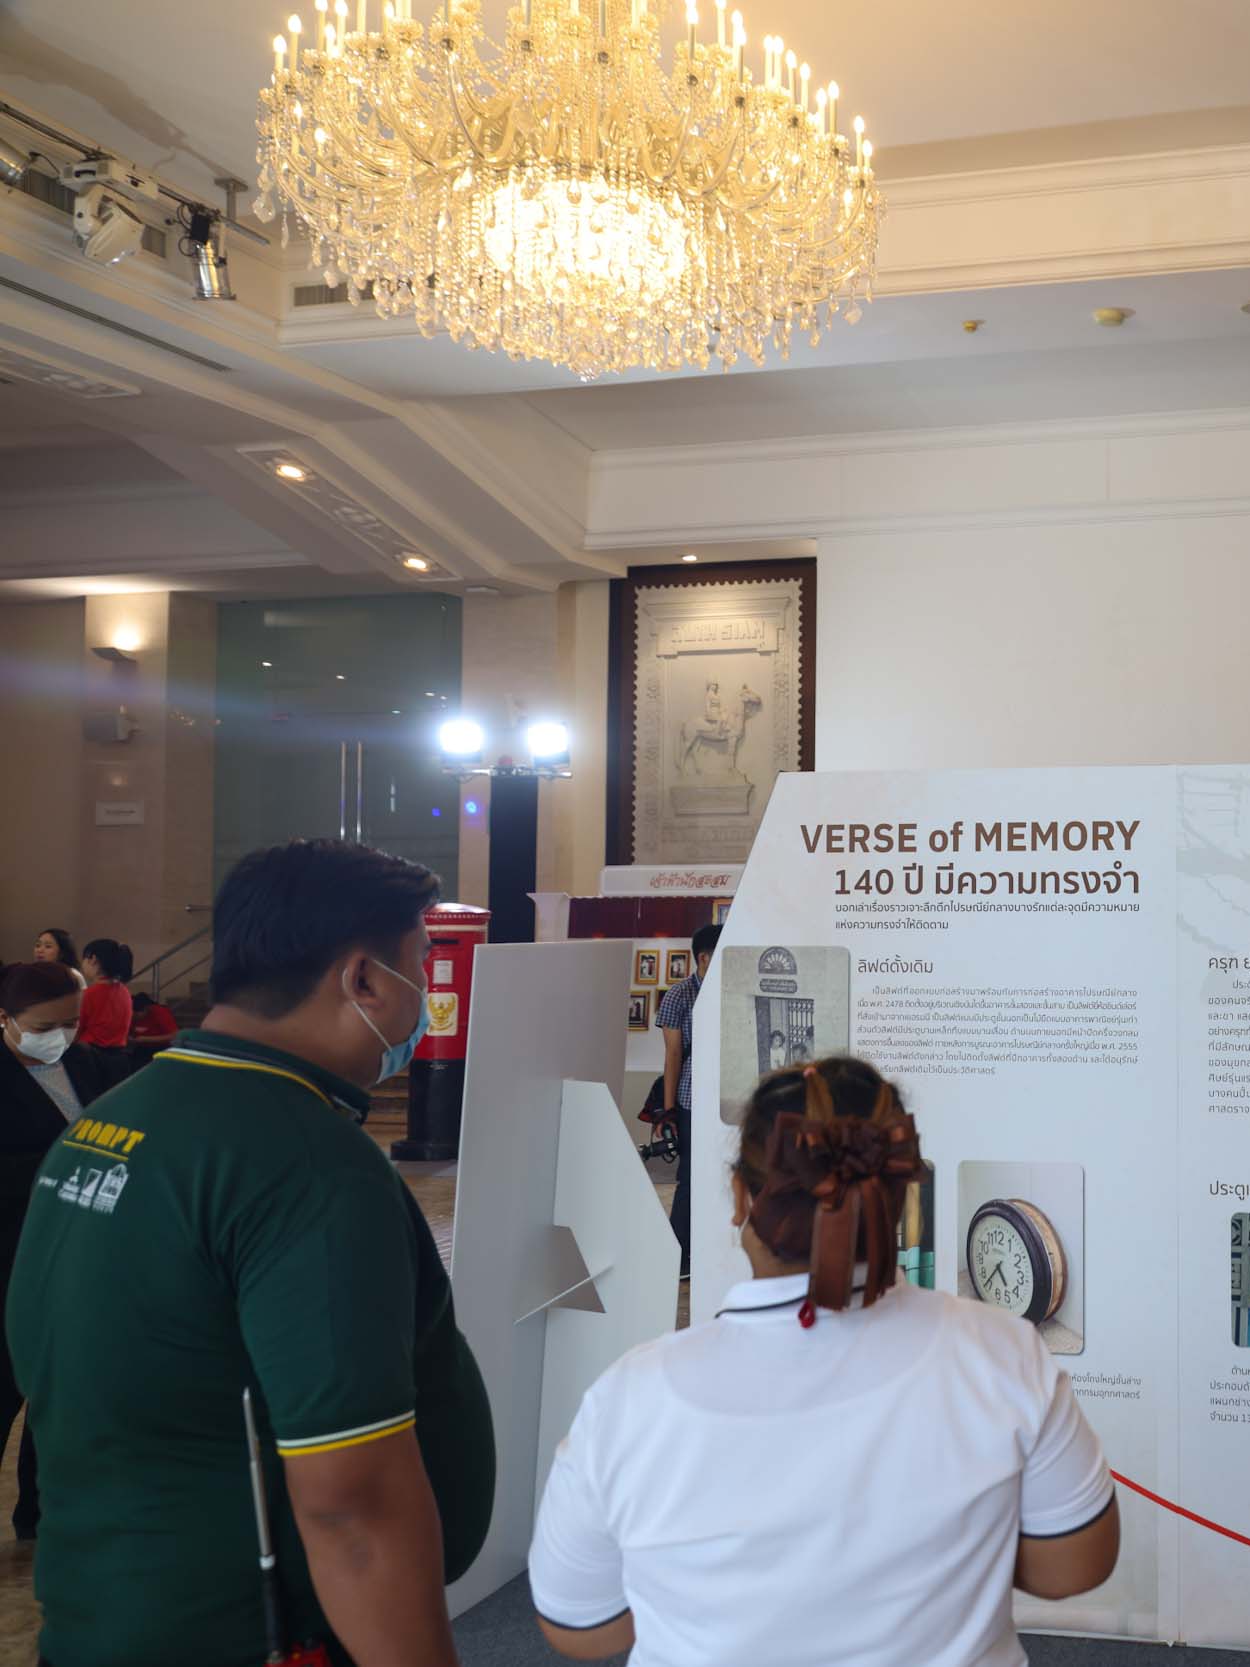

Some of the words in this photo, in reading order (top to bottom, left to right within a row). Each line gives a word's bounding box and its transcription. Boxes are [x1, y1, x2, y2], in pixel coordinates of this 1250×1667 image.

[801, 823, 918, 853] VERSE
[928, 821, 964, 853] of
[975, 820, 1141, 852] MEMORY
[835, 868, 894, 896] 140
[903, 862, 924, 895] ปี
[935, 860, 1140, 895] มีความทรงจำ
[835, 917, 949, 930] แห่งความทรงจำให้ติดตาม
[857, 954, 934, 974] ลิฟต์ดั้งเดิม
[1208, 957, 1239, 974] ครุฑ
